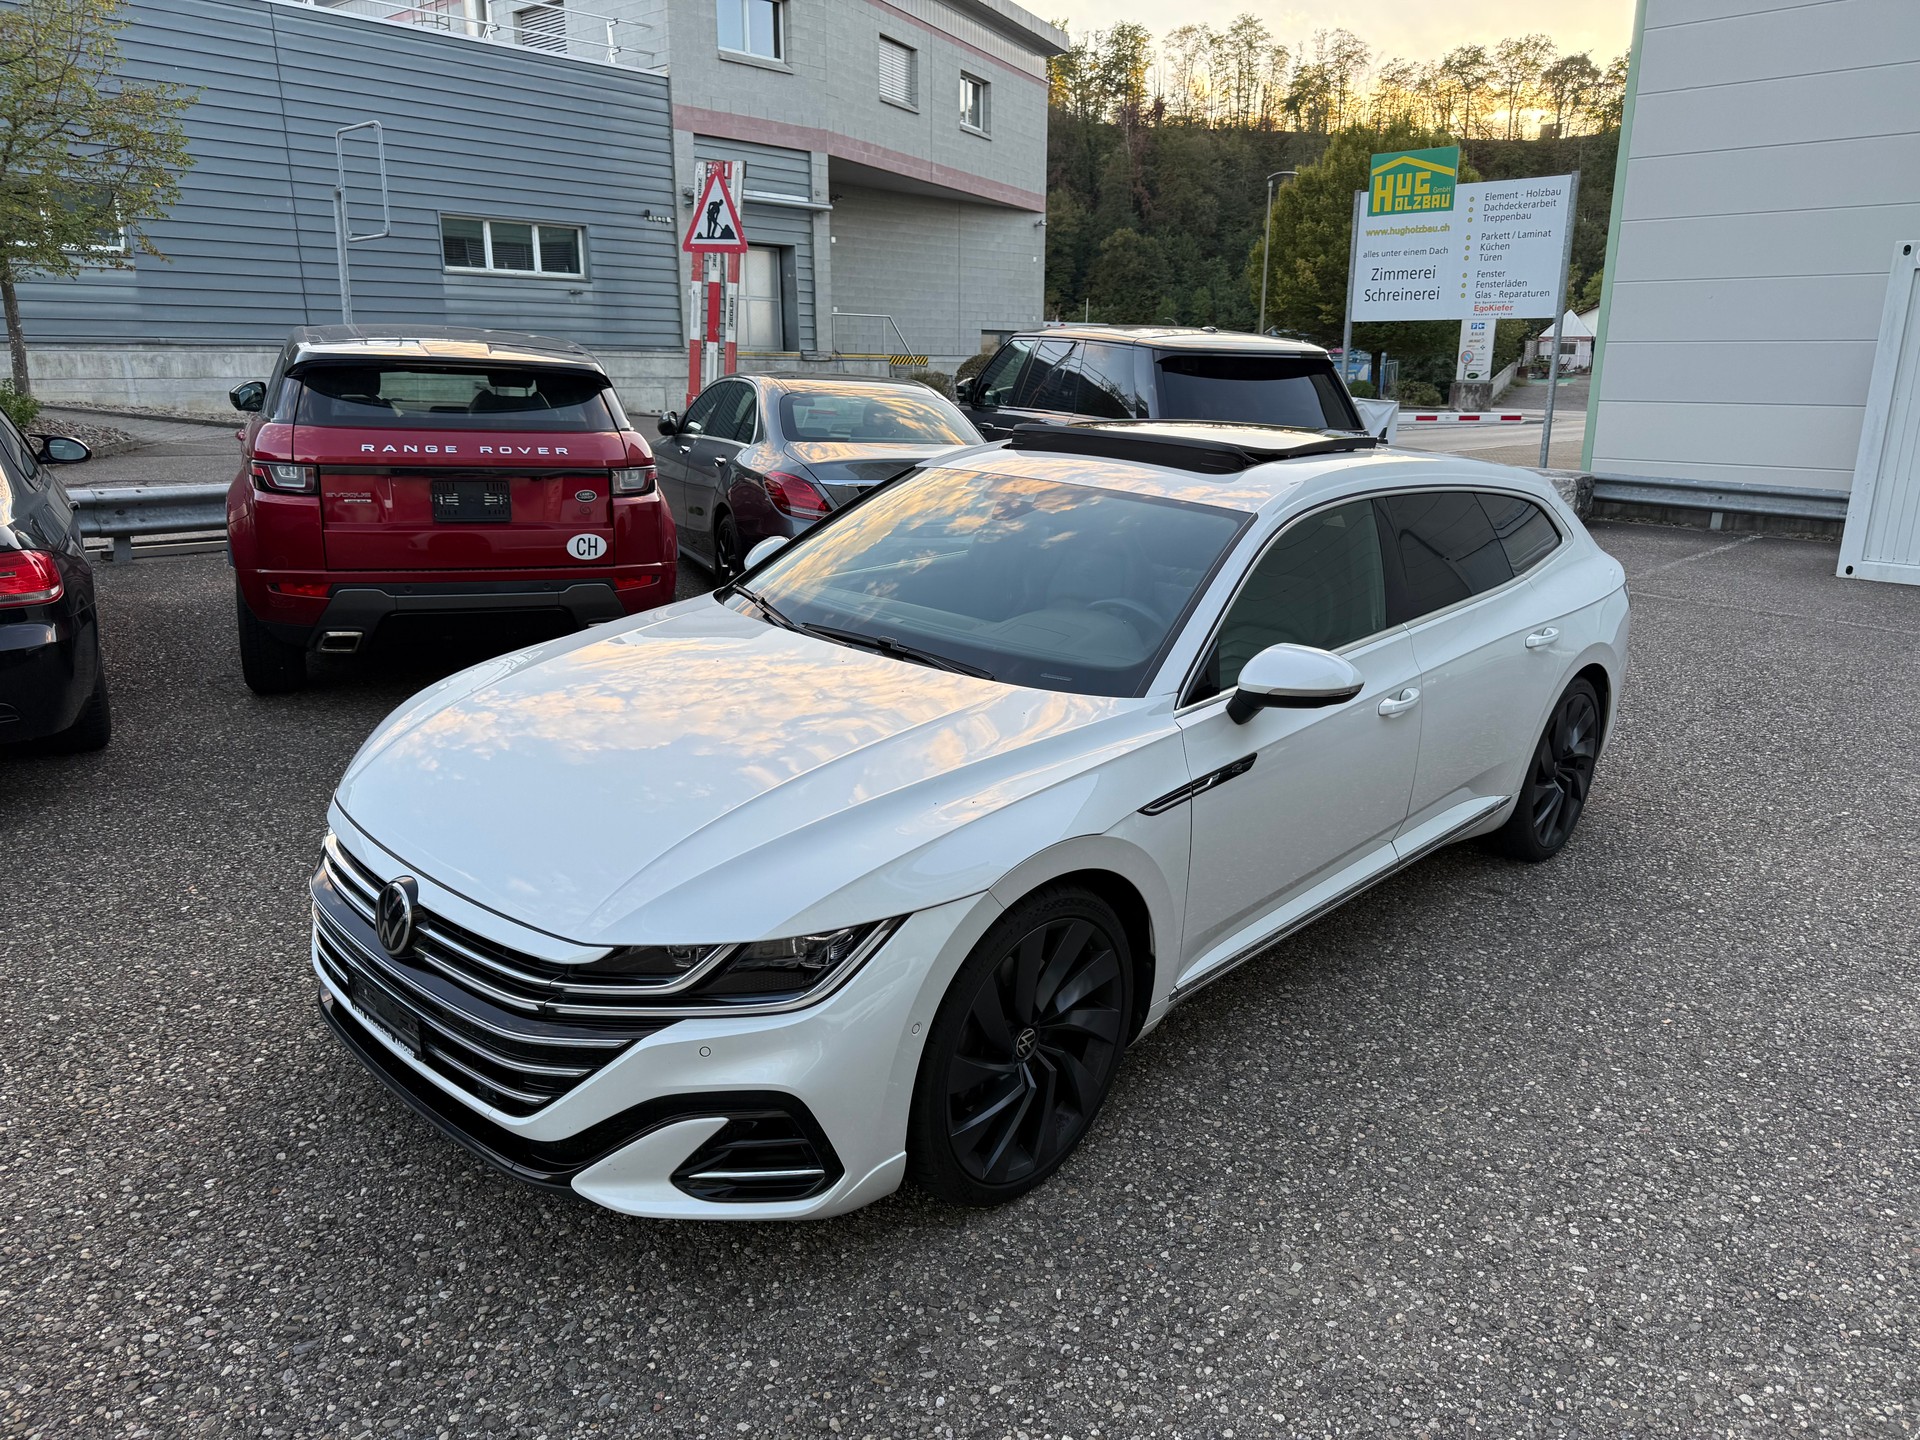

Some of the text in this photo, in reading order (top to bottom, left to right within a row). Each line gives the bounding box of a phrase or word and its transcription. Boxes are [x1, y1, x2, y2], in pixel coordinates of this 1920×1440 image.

[1485, 191, 1518, 201] Element
[1526, 188, 1561, 198] Holzbau
[1484, 199, 1557, 211] Dachdeckerarbeit
[1483, 212, 1531, 223] Treppenbau
[1366, 223, 1450, 236] www.hugholzbau.ch
[1481, 232, 1510, 241] Parkett
[1518, 229, 1551, 239] Laminat
[1480, 242, 1510, 251] Küchen
[1363, 250, 1379, 258] alles
[1403, 248, 1427, 256] einem
[1429, 247, 1448, 255] Dach
[1480, 253, 1502, 261] Türen
[1371, 265, 1436, 281] Zimmerei
[1477, 270, 1506, 278] Fenster
[1476, 279, 1527, 288] Fensterläden
[1364, 286, 1440, 302] Schreinerei
[1475, 291, 1491, 299] Glas
[1499, 290, 1550, 299] Reparaturen
[1474, 304, 1514, 312] EgoKiefer
[361, 444, 569, 455] RANGE ROVER
[576, 537, 597, 556] CH
